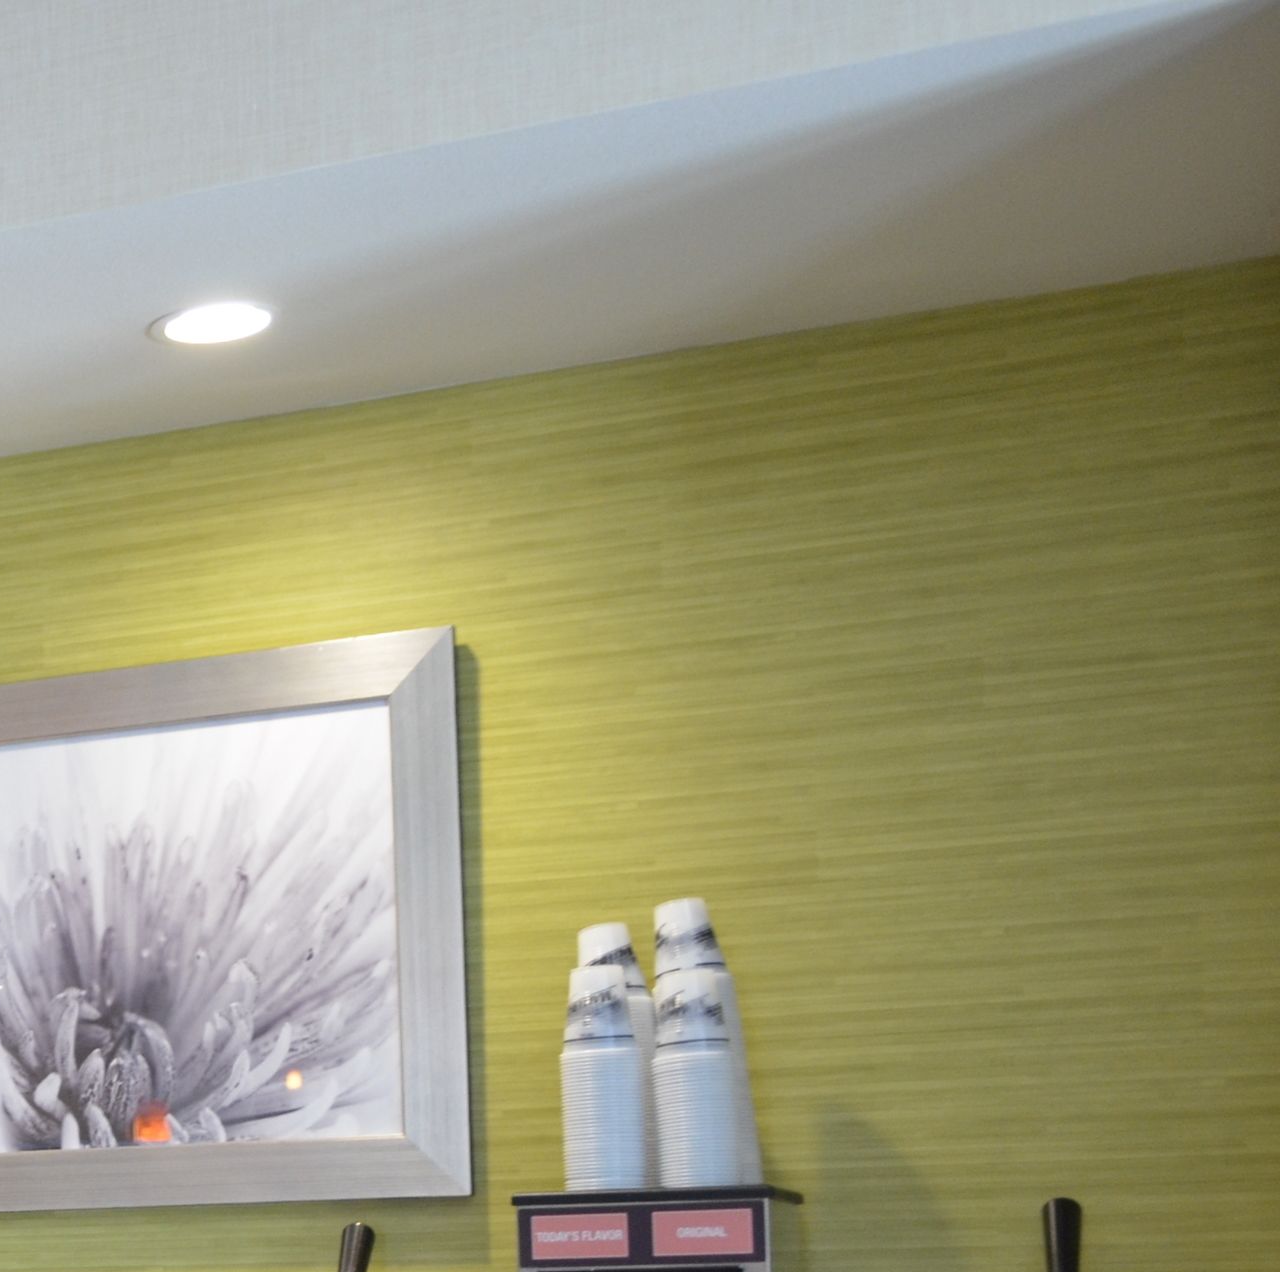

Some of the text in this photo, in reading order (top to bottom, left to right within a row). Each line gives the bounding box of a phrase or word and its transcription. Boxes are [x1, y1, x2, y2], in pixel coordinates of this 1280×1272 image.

[536, 1229, 624, 1243] TODAY'S FLAVOR
[676, 1226, 728, 1239] ORIGINAL
